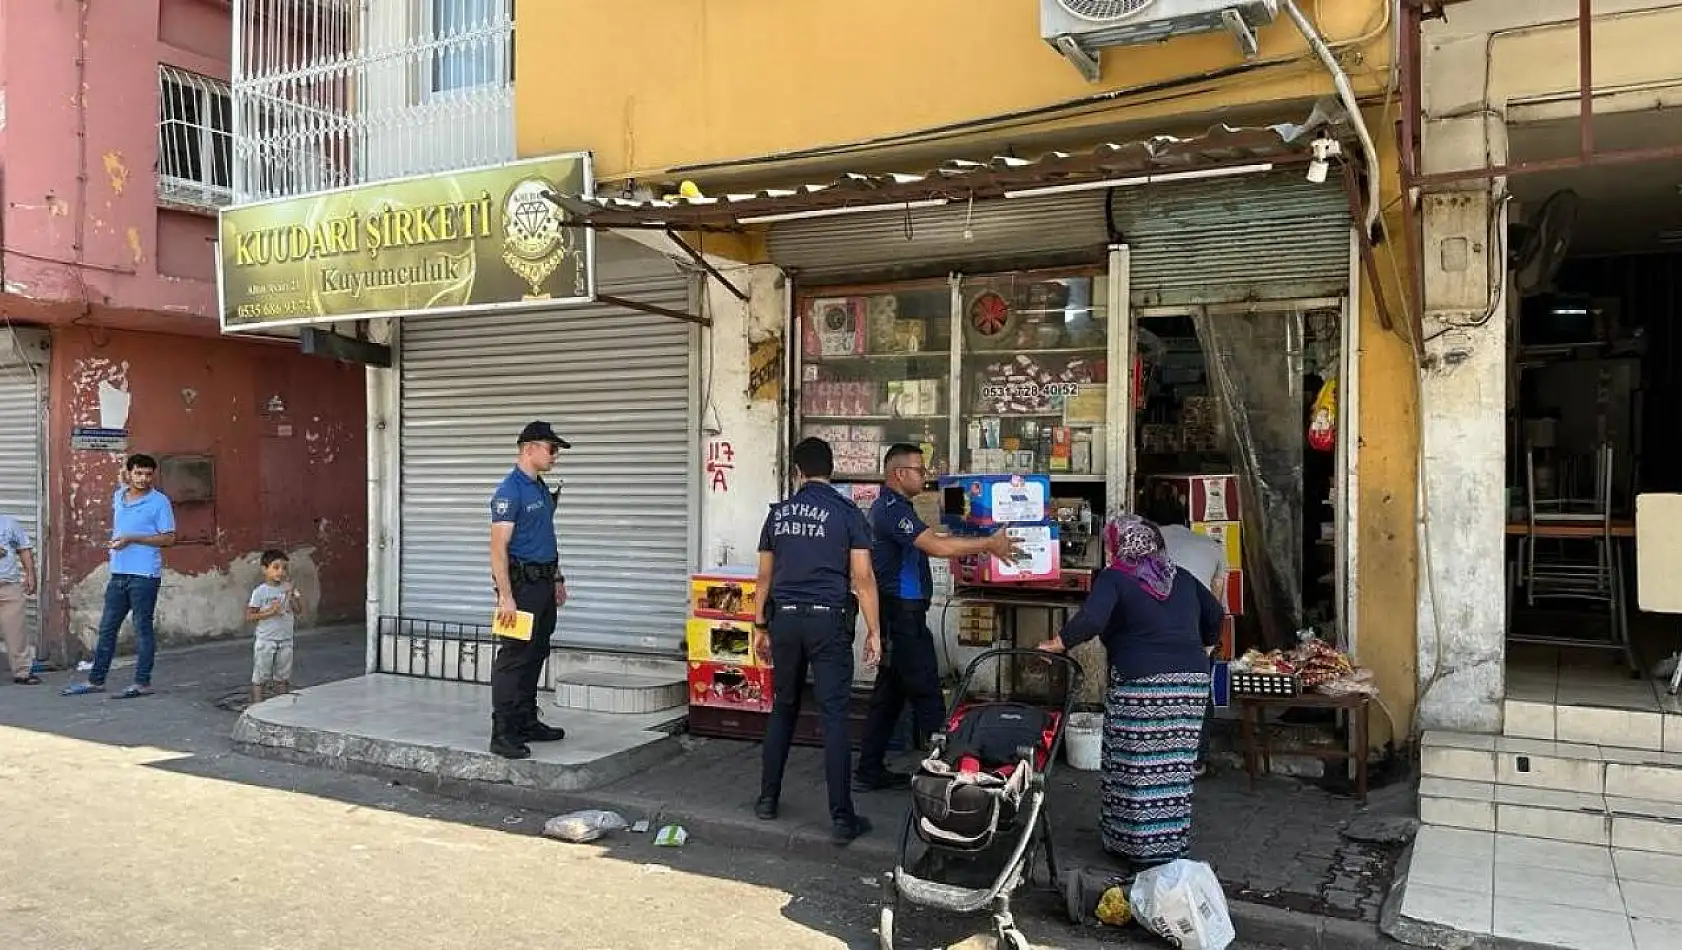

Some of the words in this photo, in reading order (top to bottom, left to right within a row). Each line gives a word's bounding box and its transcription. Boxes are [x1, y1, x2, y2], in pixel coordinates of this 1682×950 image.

[235, 210, 360, 267] KUUDARİ
[366, 190, 493, 261] ŞİRKETİ
[321, 256, 460, 299] Kuyumculuk
[1044, 383, 1059, 397] 40
[709, 441, 735, 462] 117
[713, 470, 728, 493] A
[774, 521, 826, 538] ZABITA
